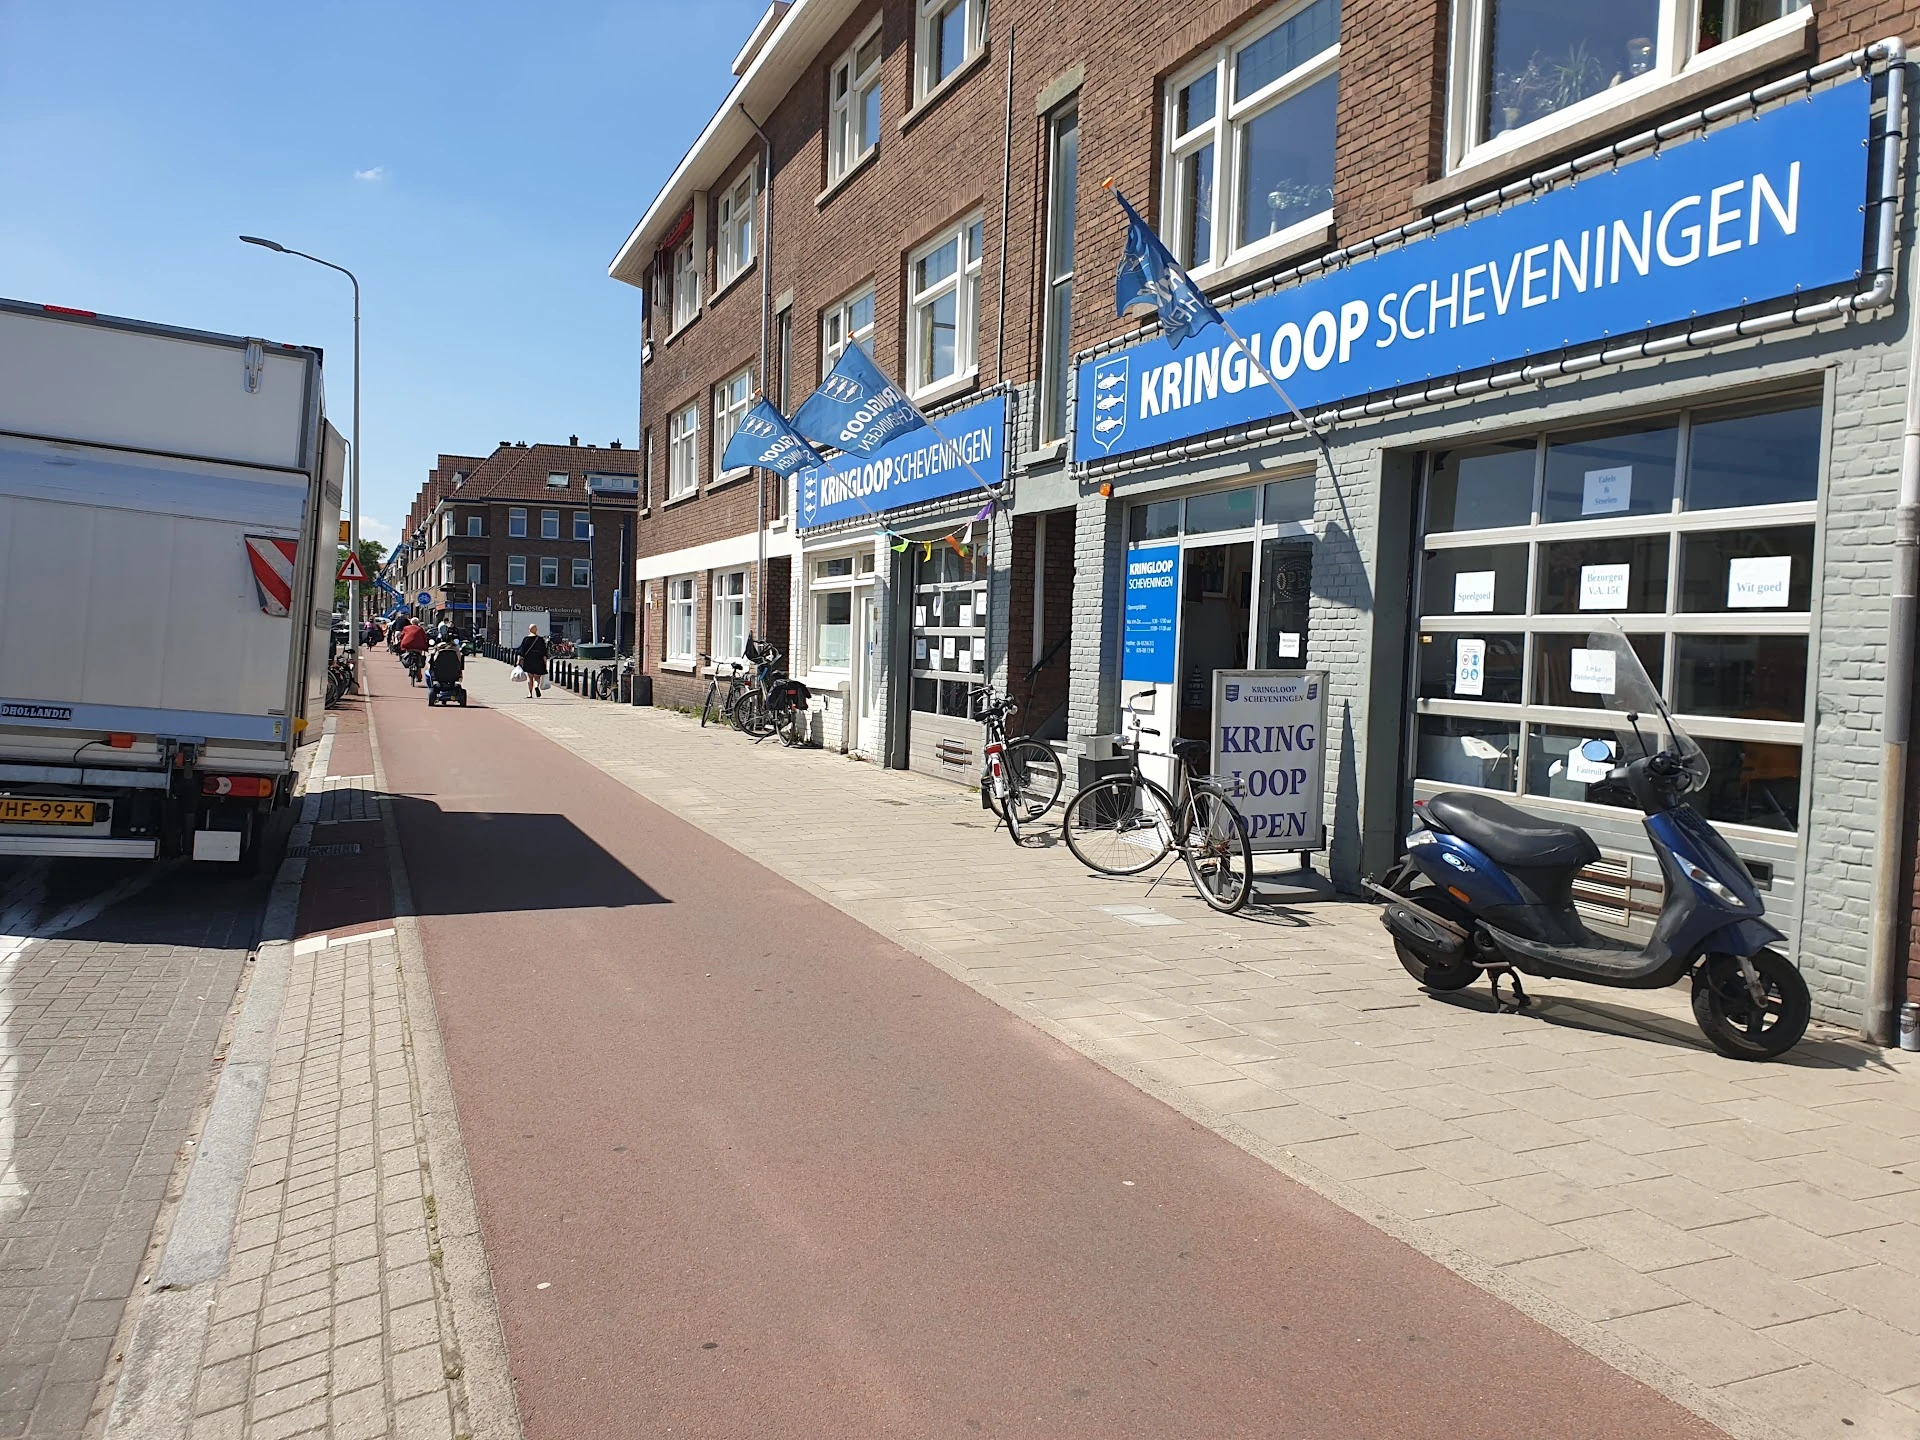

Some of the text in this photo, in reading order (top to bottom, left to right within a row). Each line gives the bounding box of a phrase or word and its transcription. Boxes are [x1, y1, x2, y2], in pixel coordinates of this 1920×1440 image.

[1139, 160, 1801, 420] KRINGLOOP SCHEVENINGEN
[820, 426, 993, 508] KRINGLOOP SCHEVENINGEN
[1129, 559, 1174, 576] KRINGLOOP
[1128, 576, 1174, 590] SCHEVENINGEN
[1276, 570, 1311, 590] OPE
[1586, 572, 1624, 584] Bezorgen
[1736, 581, 1782, 595] Wit goed
[1458, 590, 1491, 603] Speelgoed
[514, 603, 544, 612] Onesta
[1586, 664, 1602, 673] Leke
[1251, 685, 1297, 694] KRINGLOOP
[1243, 695, 1305, 703] SCHEVENINGEN
[2, 705, 71, 719] DHOLLANDIA
[1220, 724, 1316, 754] KRING
[1576, 765, 1605, 777] Fauteuils
[1231, 768, 1308, 798] LOOP
[1228, 811, 1308, 841] OPEN
